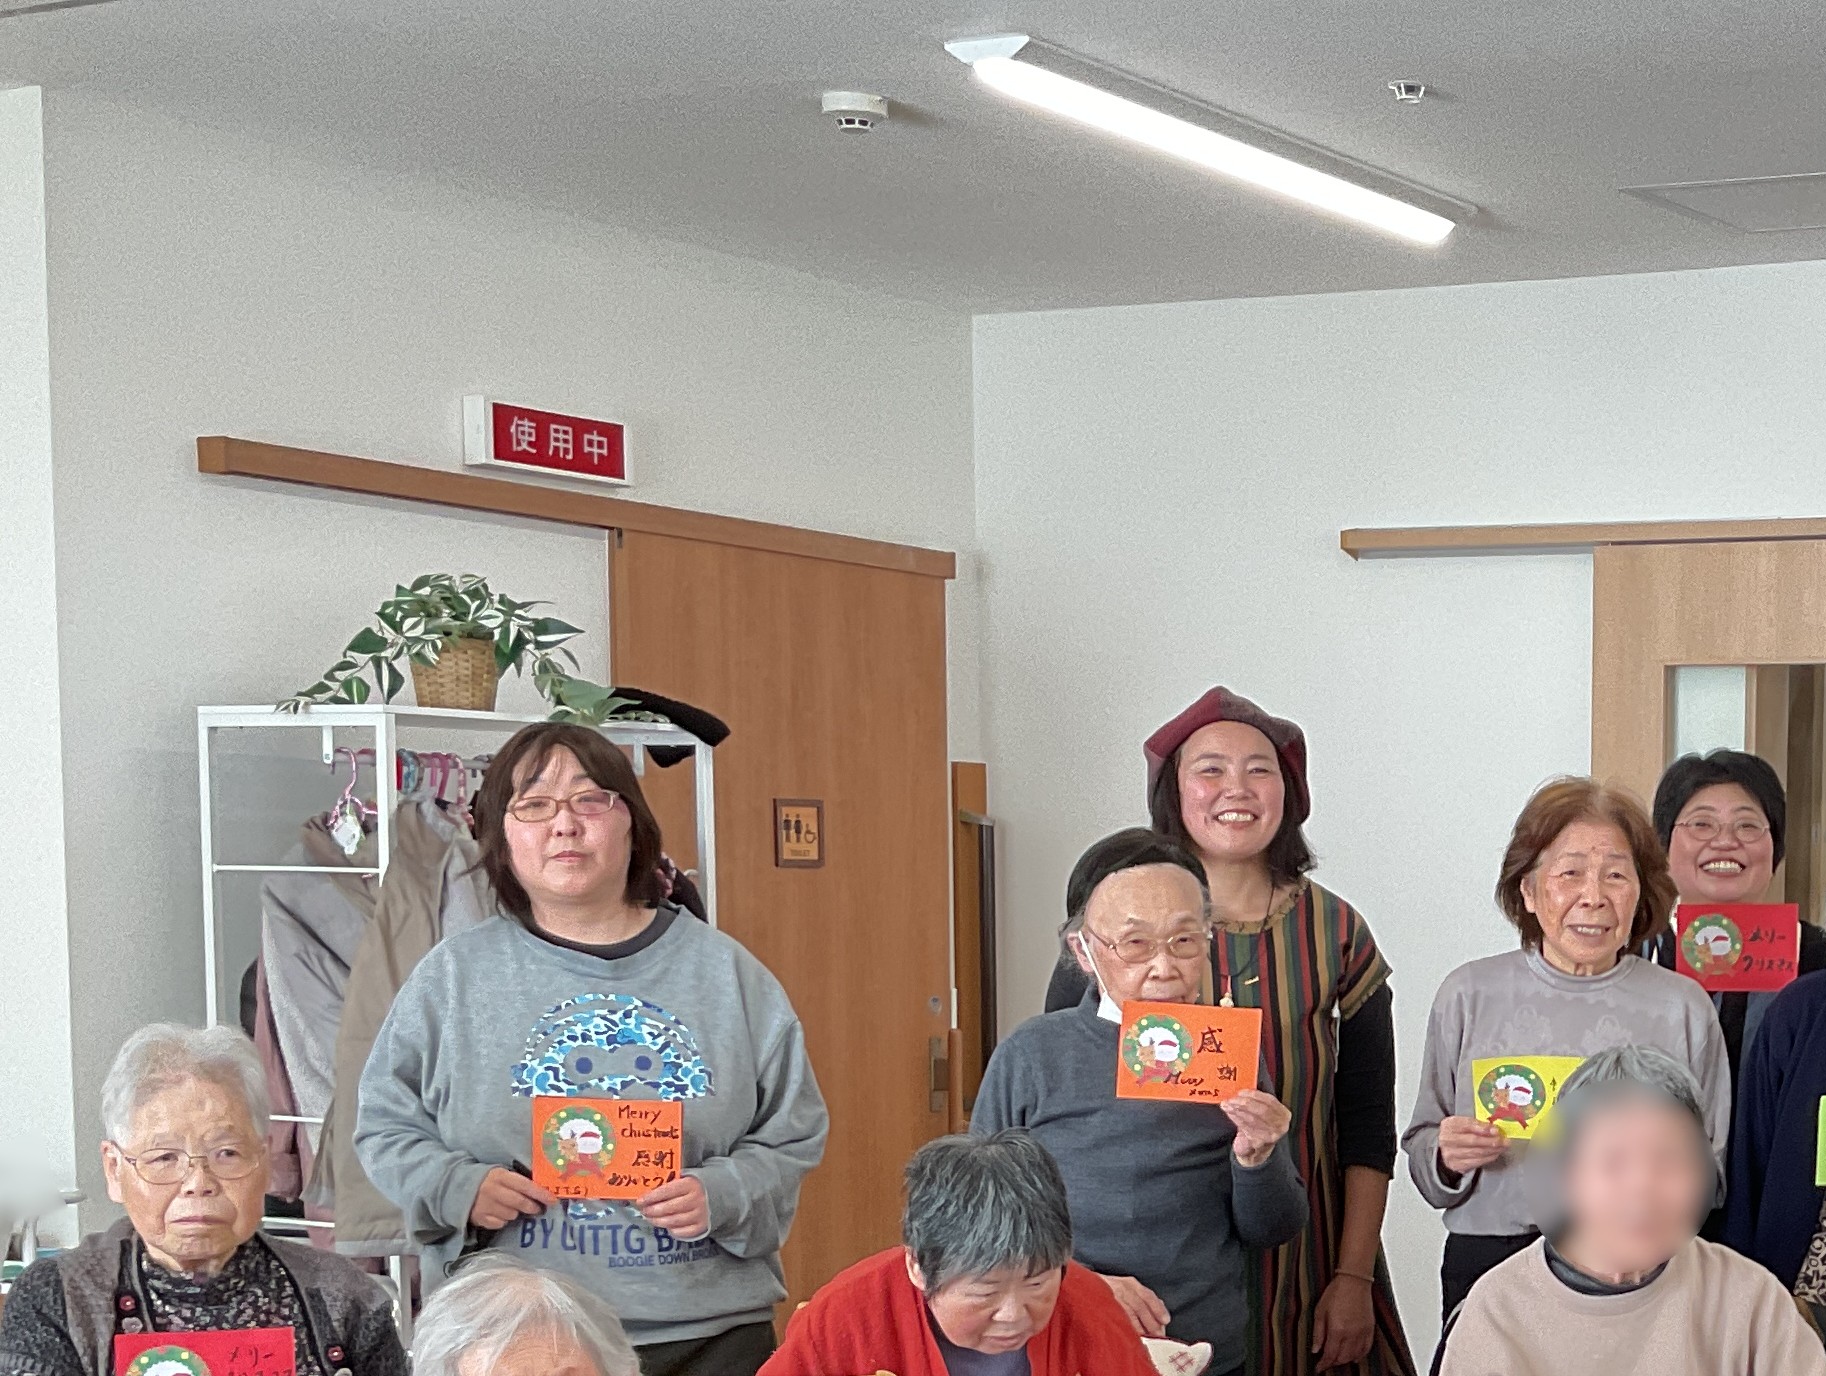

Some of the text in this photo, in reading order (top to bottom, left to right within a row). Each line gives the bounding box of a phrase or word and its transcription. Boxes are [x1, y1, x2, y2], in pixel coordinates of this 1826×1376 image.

[510, 416, 608, 465] 使用中
[618, 1105, 661, 1125] Merry
[608, 1255, 655, 1268] BOOGIE
[658, 1253, 690, 1265] DOWN
